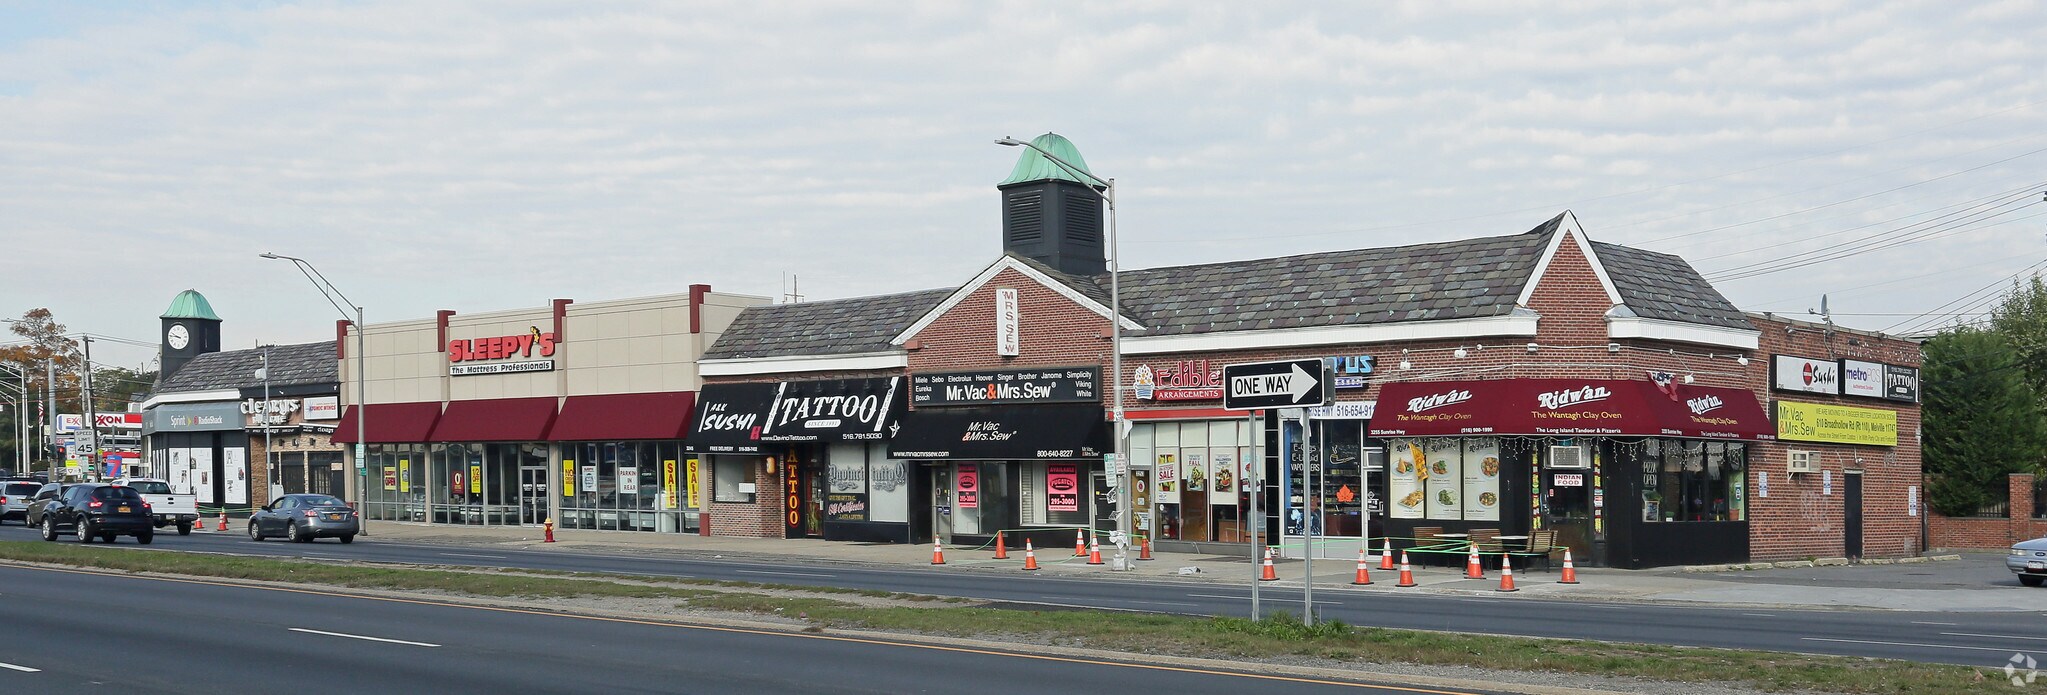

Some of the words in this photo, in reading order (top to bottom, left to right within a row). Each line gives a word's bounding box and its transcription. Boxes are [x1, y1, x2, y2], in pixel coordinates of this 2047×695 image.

[449, 333, 554, 362] SLEEPY'S
[500, 362, 550, 371] Professionals
[915, 376, 928, 384] Miele
[976, 374, 993, 382] Hoover
[998, 373, 1014, 381] Singer
[1066, 371, 1092, 380] Simplicity
[1157, 359, 1220, 388] Edible
[1813, 364, 1835, 385] Sushi
[1846, 367, 1880, 384] metroPCS
[1075, 380, 1092, 389] Viking
[1234, 378, 1260, 395] ONE
[1265, 375, 1292, 392] WAY
[1888, 374, 1915, 390] TATTOO
[916, 394, 930, 402] Bosch
[1406, 389, 1472, 412] Ridwan
[1538, 385, 1612, 410] Ridwan
[779, 394, 878, 426] TATTOO
[1686, 394, 1723, 415] Ridwan
[171, 416, 186, 428] Sprint
[198, 416, 222, 425] RadioShack
[703, 413, 756, 430] SUSHI
[1410, 414, 1437, 422] Wantagh
[1548, 412, 1581, 420] Wantagh
[1582, 412, 1600, 420] Clay
[1824, 419, 1848, 429] Broadhollow
[1849, 420, 1854, 430] Rd
[1871, 422, 1885, 432] Melville
[78, 444, 92, 453] 45
[1294, 444, 1316, 453] E-Cgs
[1469, 442, 1494, 452] Ridwan
[1037, 450, 1073, 458] 800-640-8227
[1291, 463, 1320, 471] VAPOERS
[1159, 470, 1173, 479] SALE
[1644, 474, 1657, 486] OPEN
[787, 449, 798, 525] ATTOO
